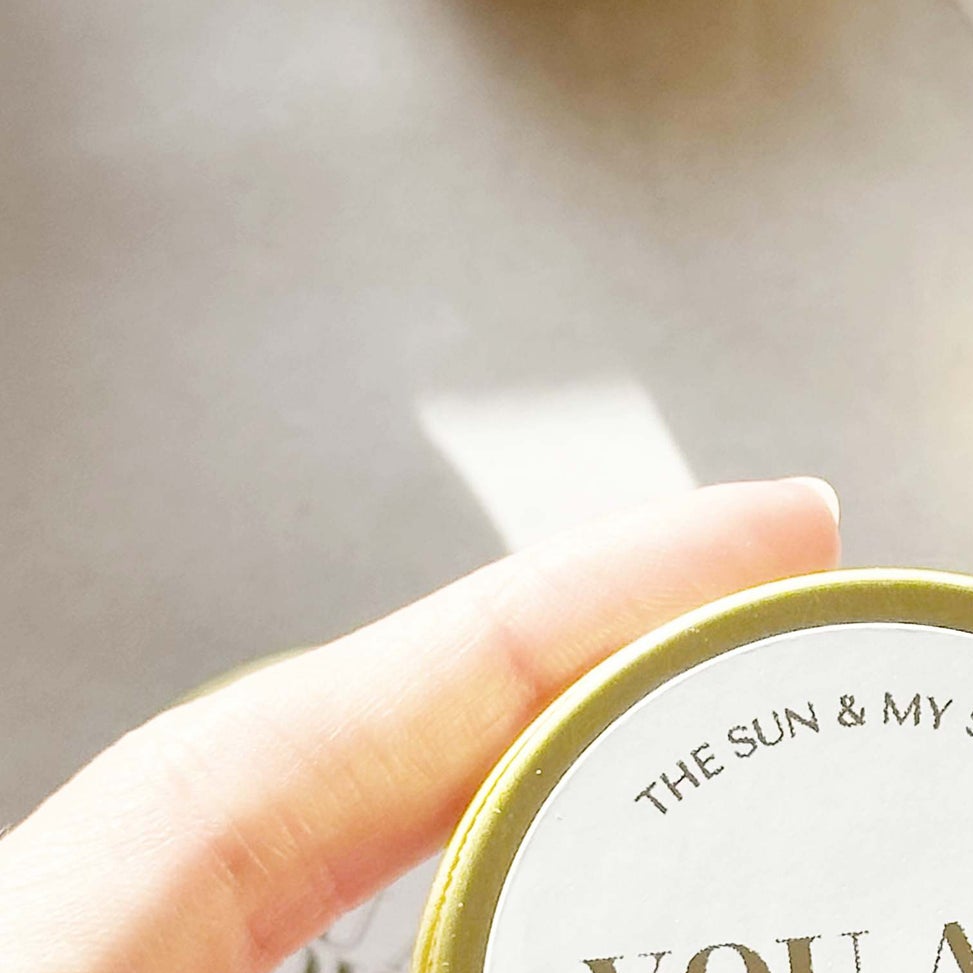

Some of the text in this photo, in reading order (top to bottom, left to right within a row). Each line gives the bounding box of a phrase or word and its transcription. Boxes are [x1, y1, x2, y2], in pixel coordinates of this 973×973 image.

[634, 741, 725, 815] THE
[728, 701, 820, 759] SUN
[836, 692, 867, 729] &
[883, 691, 954, 731] MY
